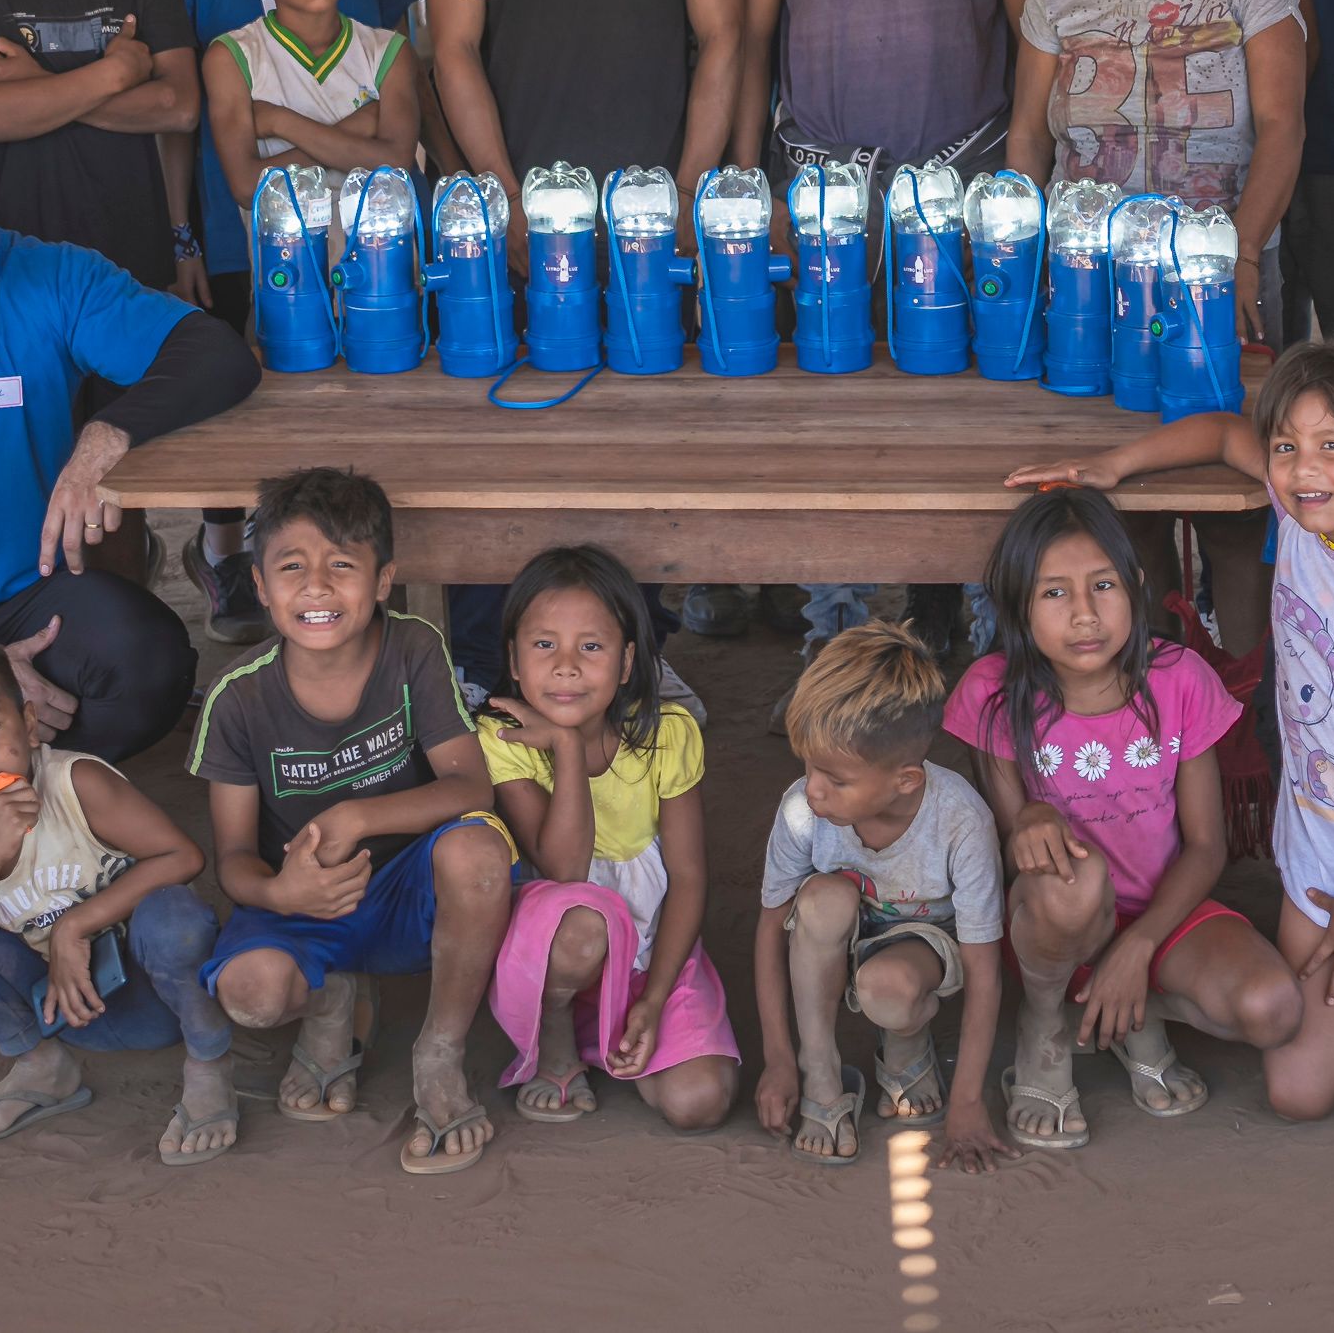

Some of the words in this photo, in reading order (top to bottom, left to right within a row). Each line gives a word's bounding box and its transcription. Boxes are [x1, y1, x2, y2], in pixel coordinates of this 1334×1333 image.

[281, 762, 328, 778] CATCH
[332, 745, 362, 767] THE
[366, 722, 404, 753] WAVES
[352, 769, 391, 790] SUMMER
